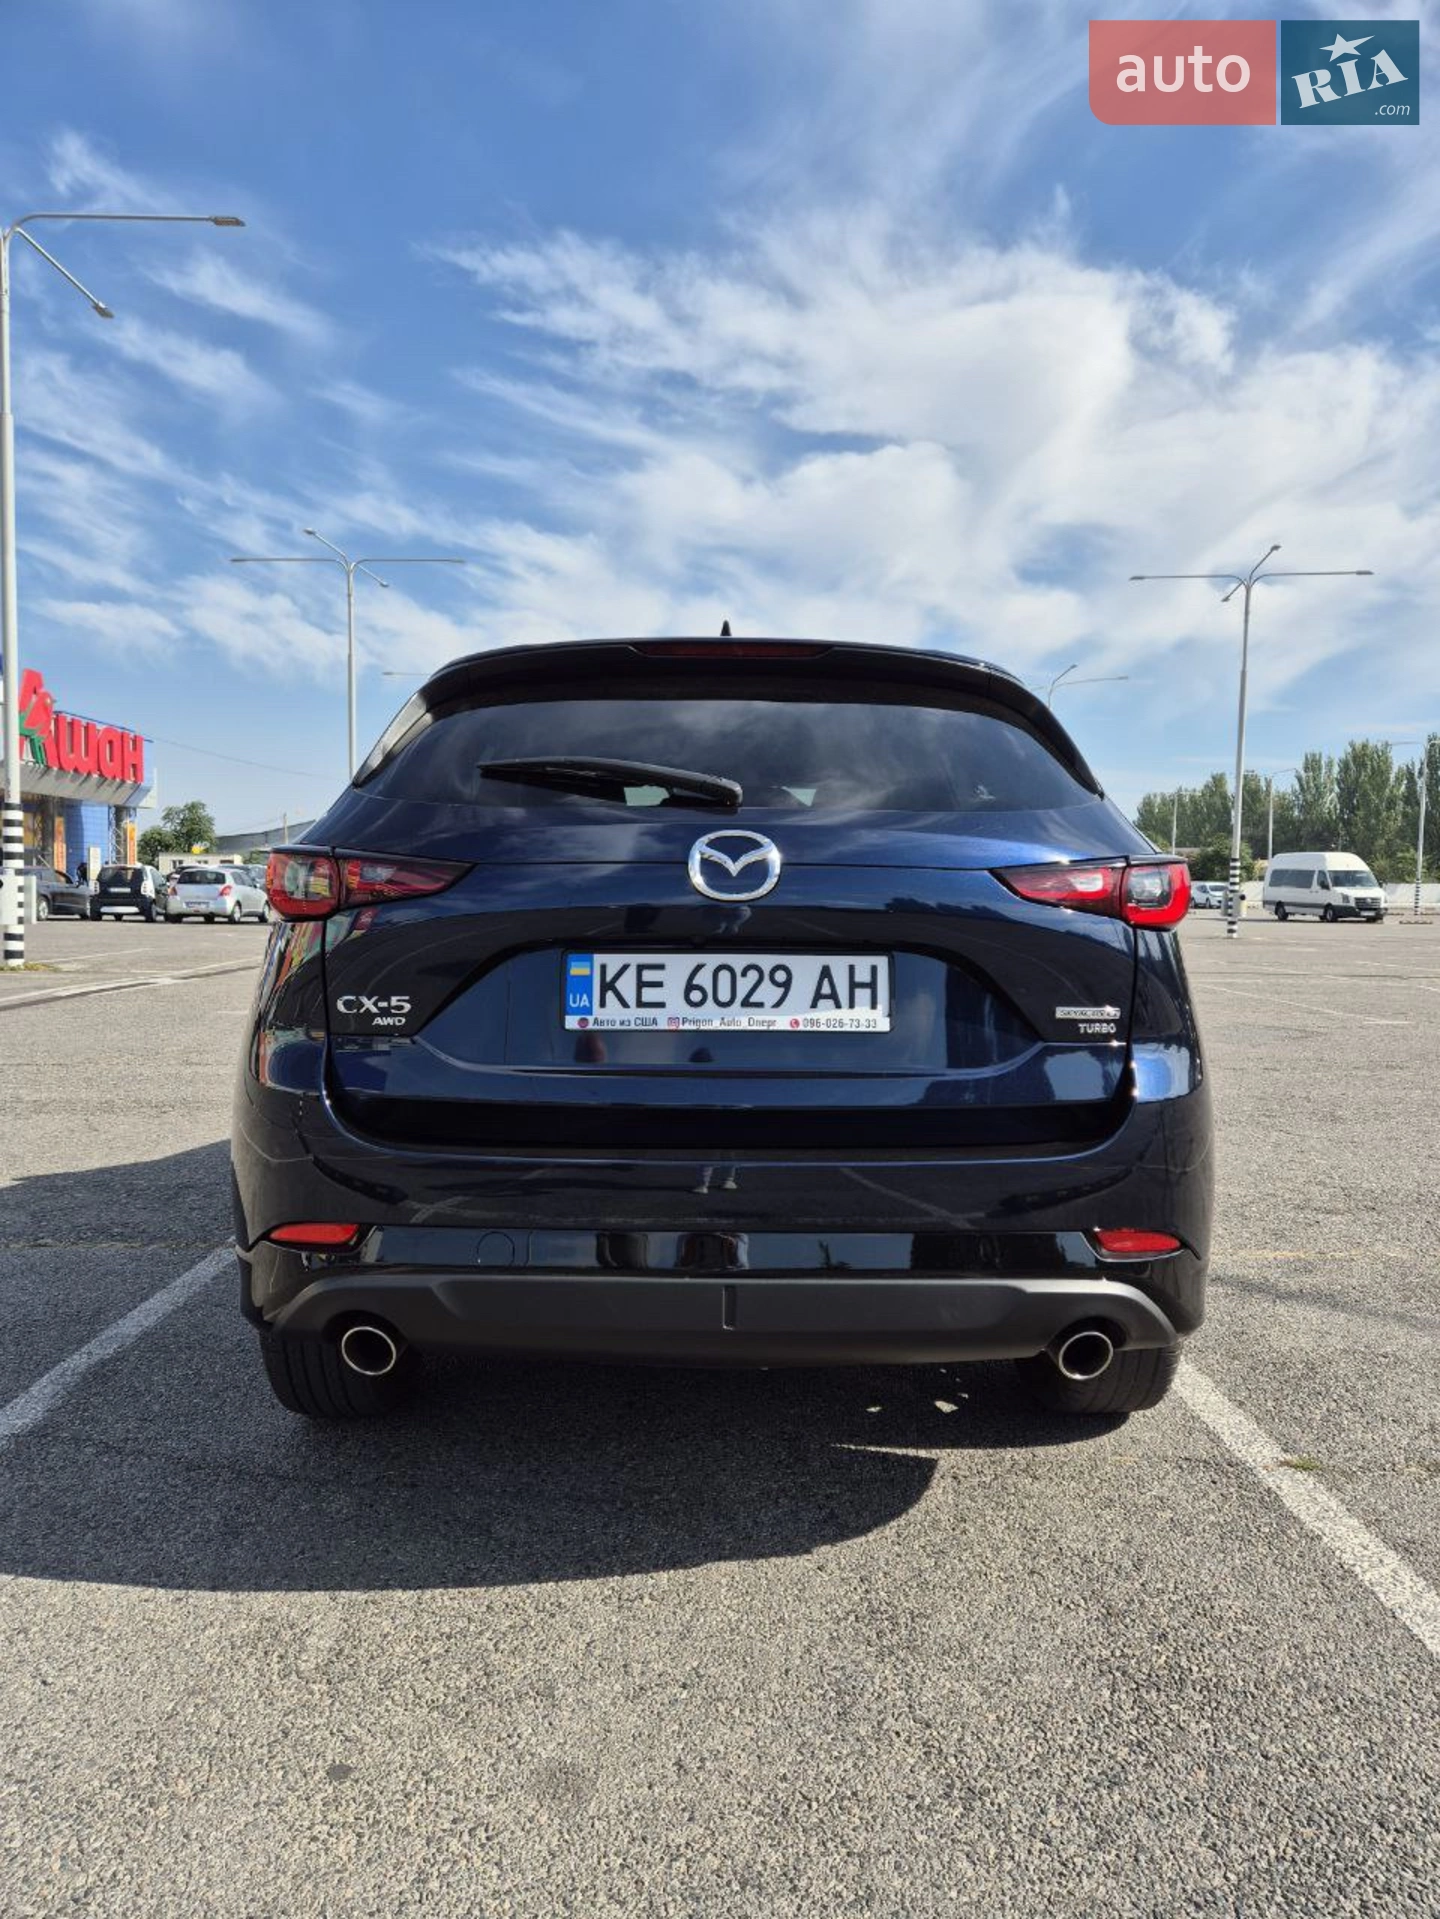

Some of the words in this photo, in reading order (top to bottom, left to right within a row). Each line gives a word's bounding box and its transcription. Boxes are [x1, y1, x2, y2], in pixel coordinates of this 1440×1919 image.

[599, 963, 667, 1009] KE
[683, 963, 794, 1009] 6029
[809, 964, 879, 1010] AH
[336, 995, 412, 1014] CX-5
[569, 994, 590, 1008] UA
[371, 1016, 406, 1026] AWD
[592, 1017, 615, 1027] Авто
[619, 1019, 631, 1027] из
[634, 1017, 658, 1027] США
[1078, 1022, 1117, 1034] TURBO
